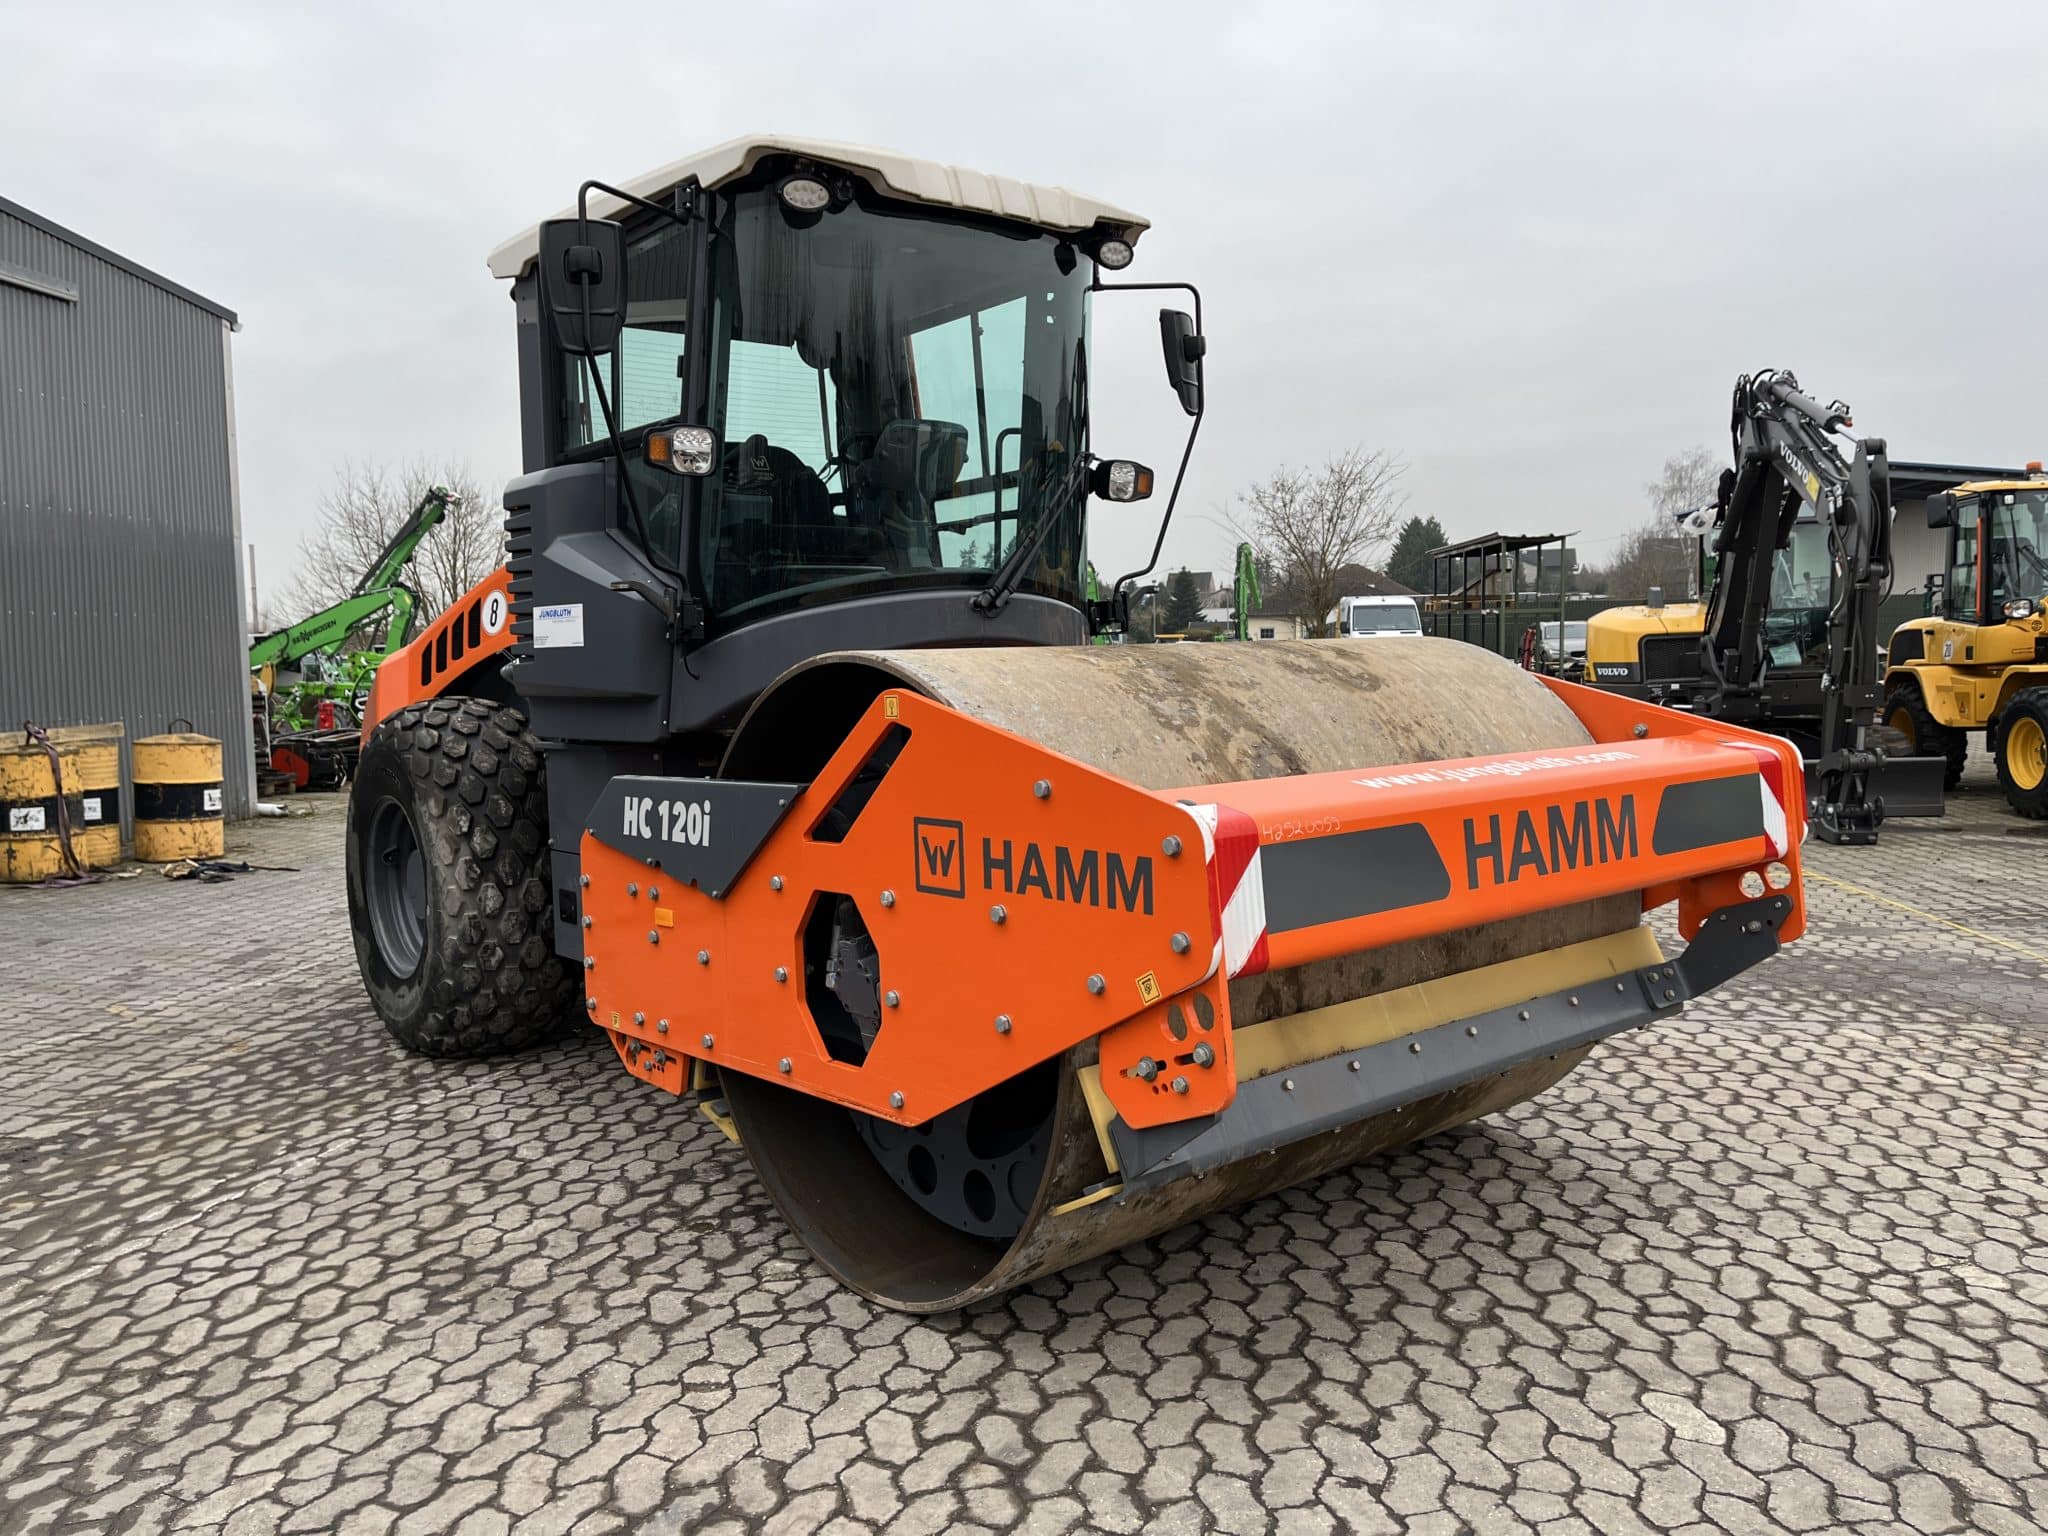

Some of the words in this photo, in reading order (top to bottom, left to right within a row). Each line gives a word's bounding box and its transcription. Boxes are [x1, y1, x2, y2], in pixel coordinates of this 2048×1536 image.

[1780, 440, 1809, 483] VOLVO
[490, 599, 499, 627] 8
[538, 608, 572, 618] JUNGBLUTH
[1597, 668, 1629, 676] VOLVO
[1352, 749, 1640, 790] www.jungbluth.com
[623, 796, 653, 839] HC
[658, 799, 711, 847] 120i
[1463, 794, 1639, 890] HAMM
[982, 837, 1154, 916] HAMM
